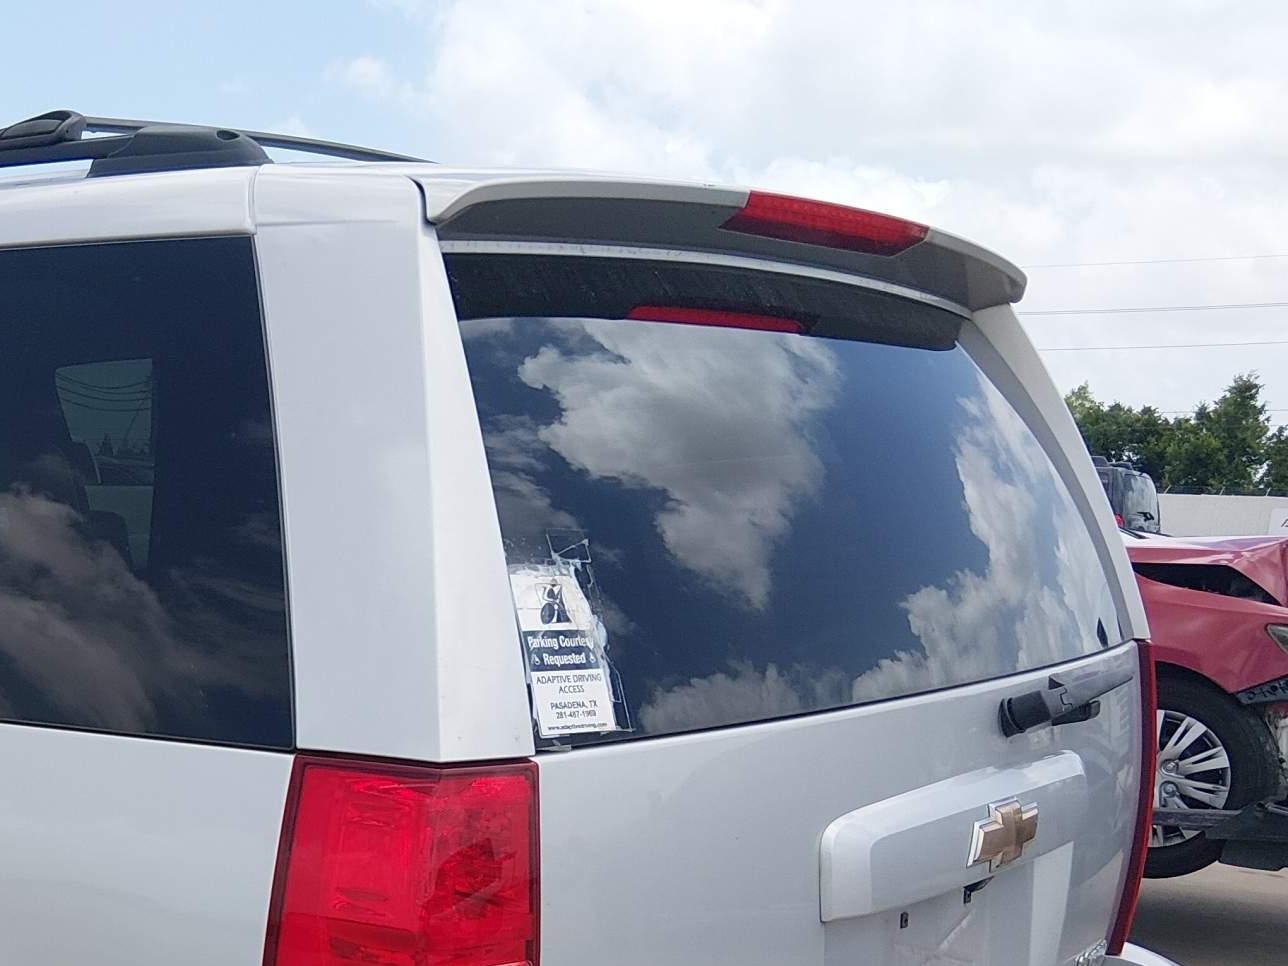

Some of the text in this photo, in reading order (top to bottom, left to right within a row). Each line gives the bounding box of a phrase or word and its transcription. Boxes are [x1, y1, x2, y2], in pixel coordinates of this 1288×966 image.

[527, 635, 559, 650] Parking
[543, 652, 587, 667] Requested
[536, 673, 602, 685] ADAPTIVE DRIVING
[558, 685, 585, 694] ACCESS
[588, 700, 598, 708] TX
